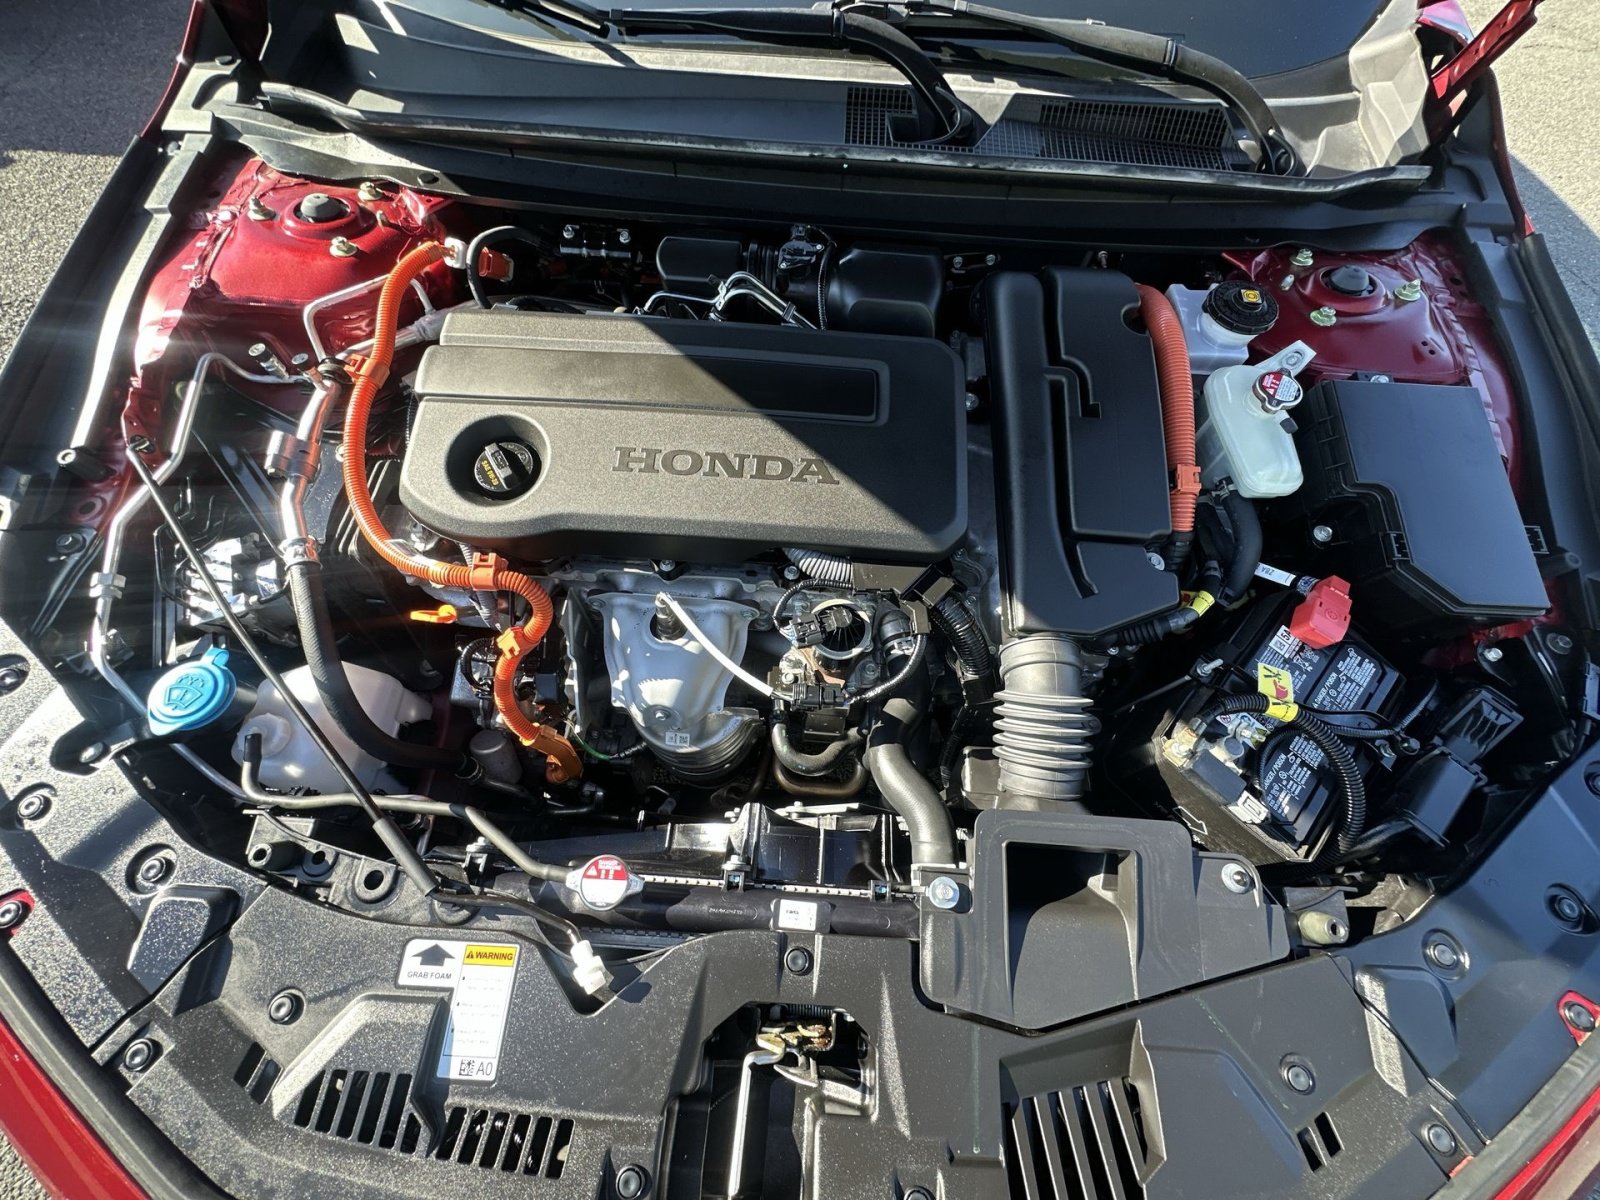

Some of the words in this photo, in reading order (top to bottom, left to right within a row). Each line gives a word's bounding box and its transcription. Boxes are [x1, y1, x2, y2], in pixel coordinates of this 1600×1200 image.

[481, 460, 492, 472] SAE
[612, 447, 840, 485] HONDA
[475, 952, 513, 961] WARNING
[407, 971, 428, 979] GRAB
[429, 972, 452, 980] FOAM
